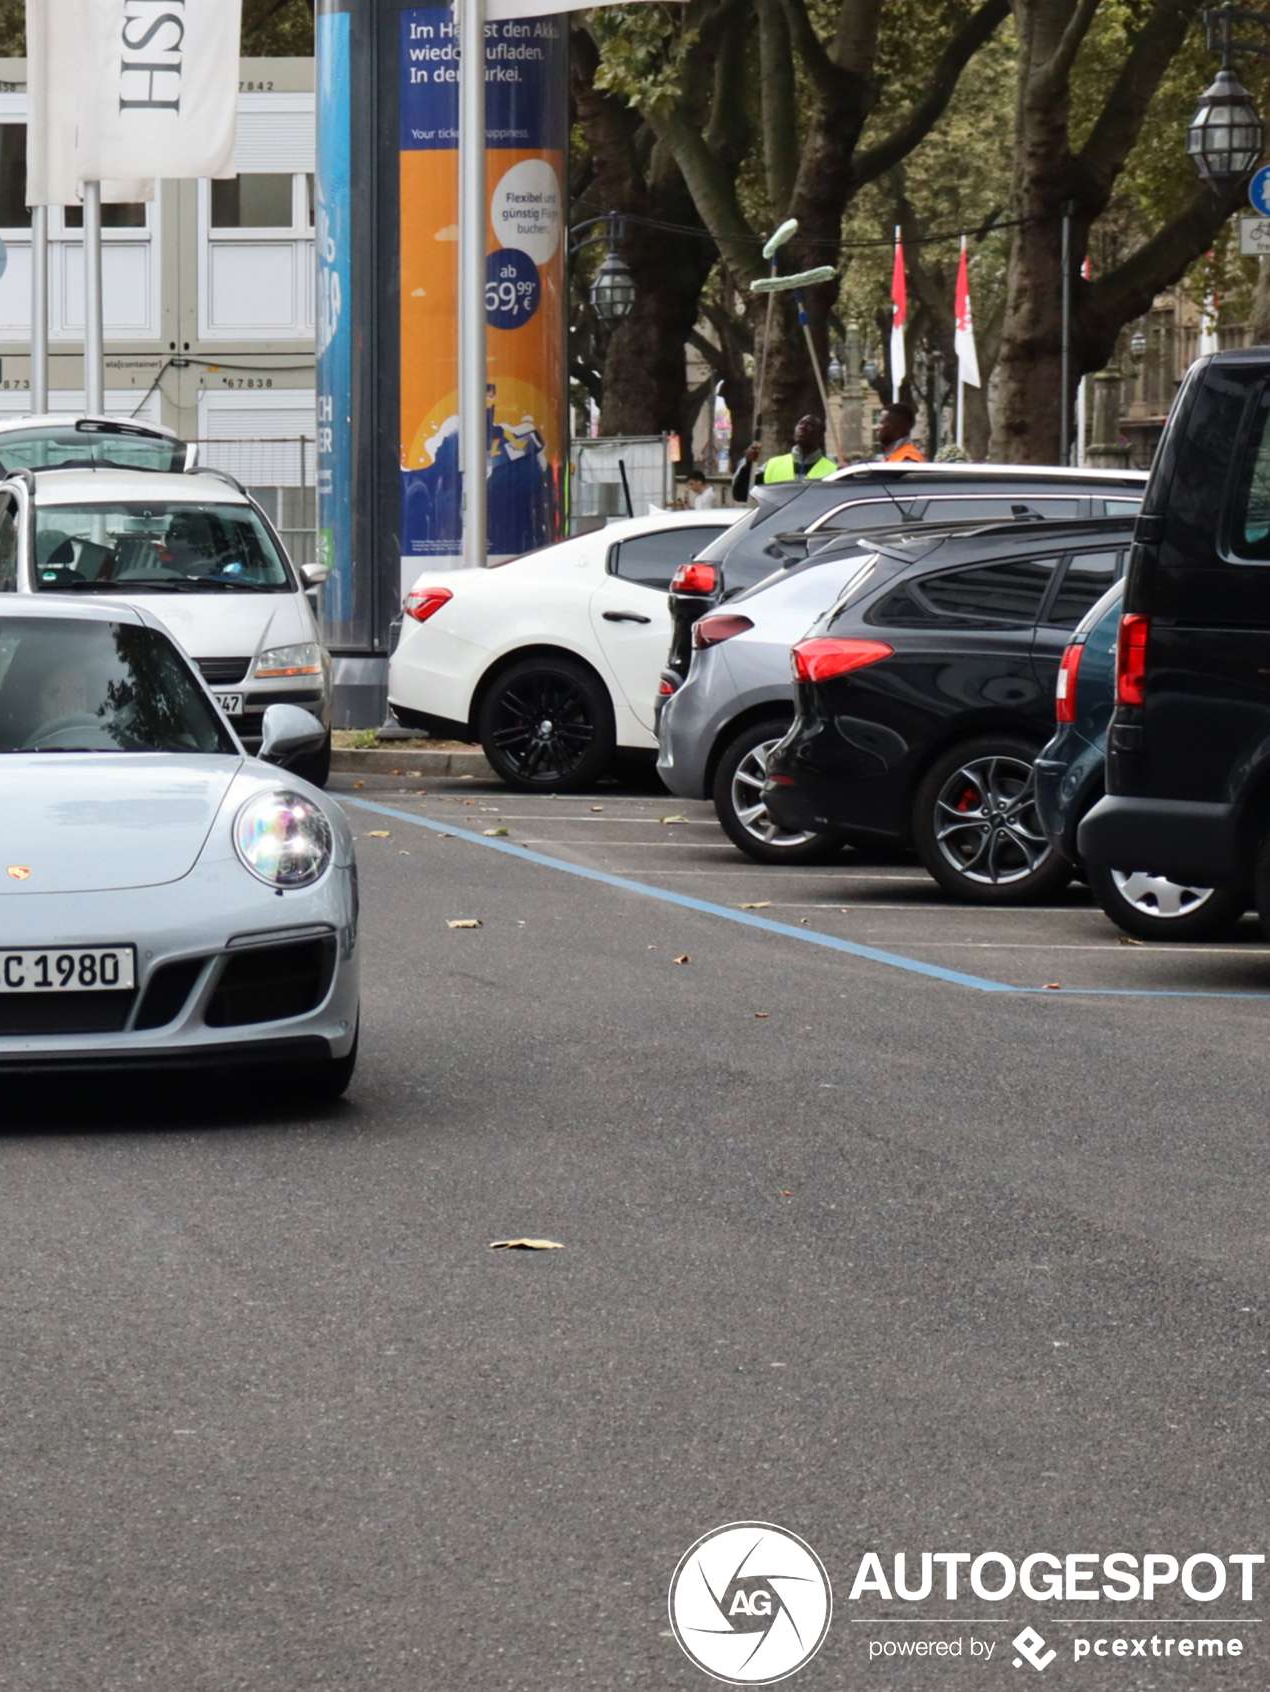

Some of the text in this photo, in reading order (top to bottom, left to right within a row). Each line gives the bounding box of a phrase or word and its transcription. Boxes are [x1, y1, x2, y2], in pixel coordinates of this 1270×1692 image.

[410, 23, 434, 39] Im
[439, 22, 499, 38] Hest
[502, 21, 530, 38] den
[410, 43, 545, 61] wiede ufladen.
[410, 67, 428, 83] In
[484, 66, 522, 82] ürkei.
[239, 81, 274, 91] 7842
[411, 129, 436, 139] Your
[485, 128, 529, 140] appiness.
[506, 192, 543, 204] Flexibel
[502, 207, 540, 222] günstig
[500, 264, 517, 278] ab
[227, 378, 273, 389] 67838
